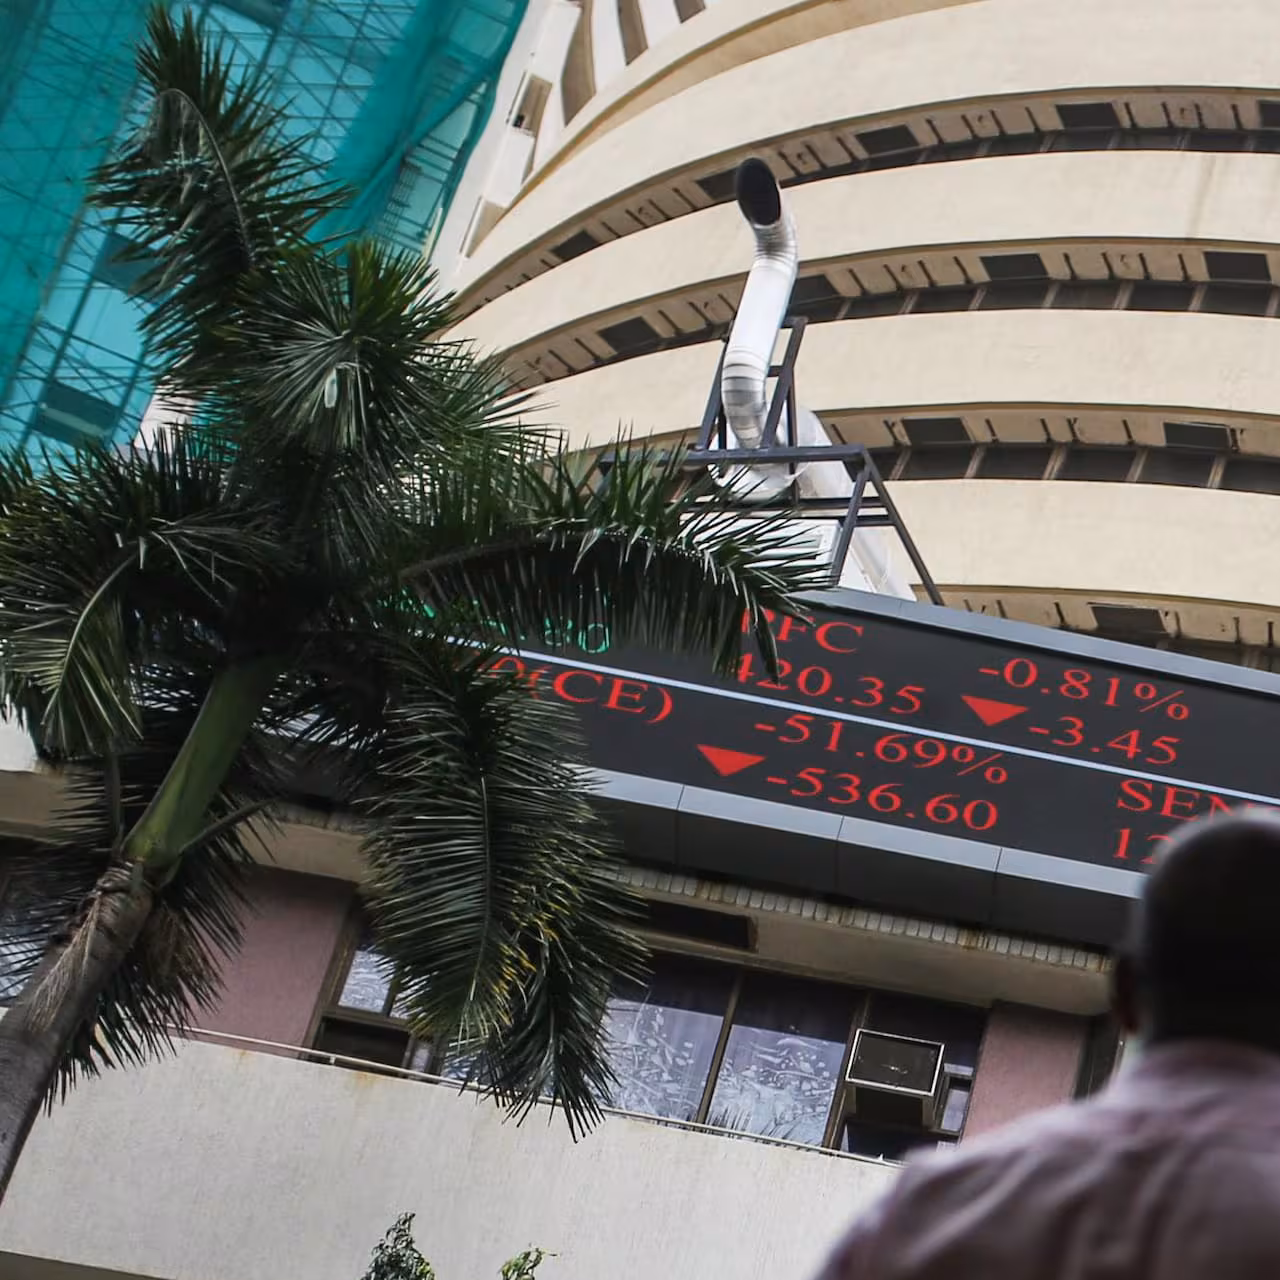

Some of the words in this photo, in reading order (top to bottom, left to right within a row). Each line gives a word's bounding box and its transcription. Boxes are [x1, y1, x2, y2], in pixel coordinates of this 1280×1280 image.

[978, 658, 1190, 720] -0.81%
[754, 714, 1008, 784] -51.69%
[1030, 716, 1182, 764] -3.45
[768, 768, 998, 830] -536.60
